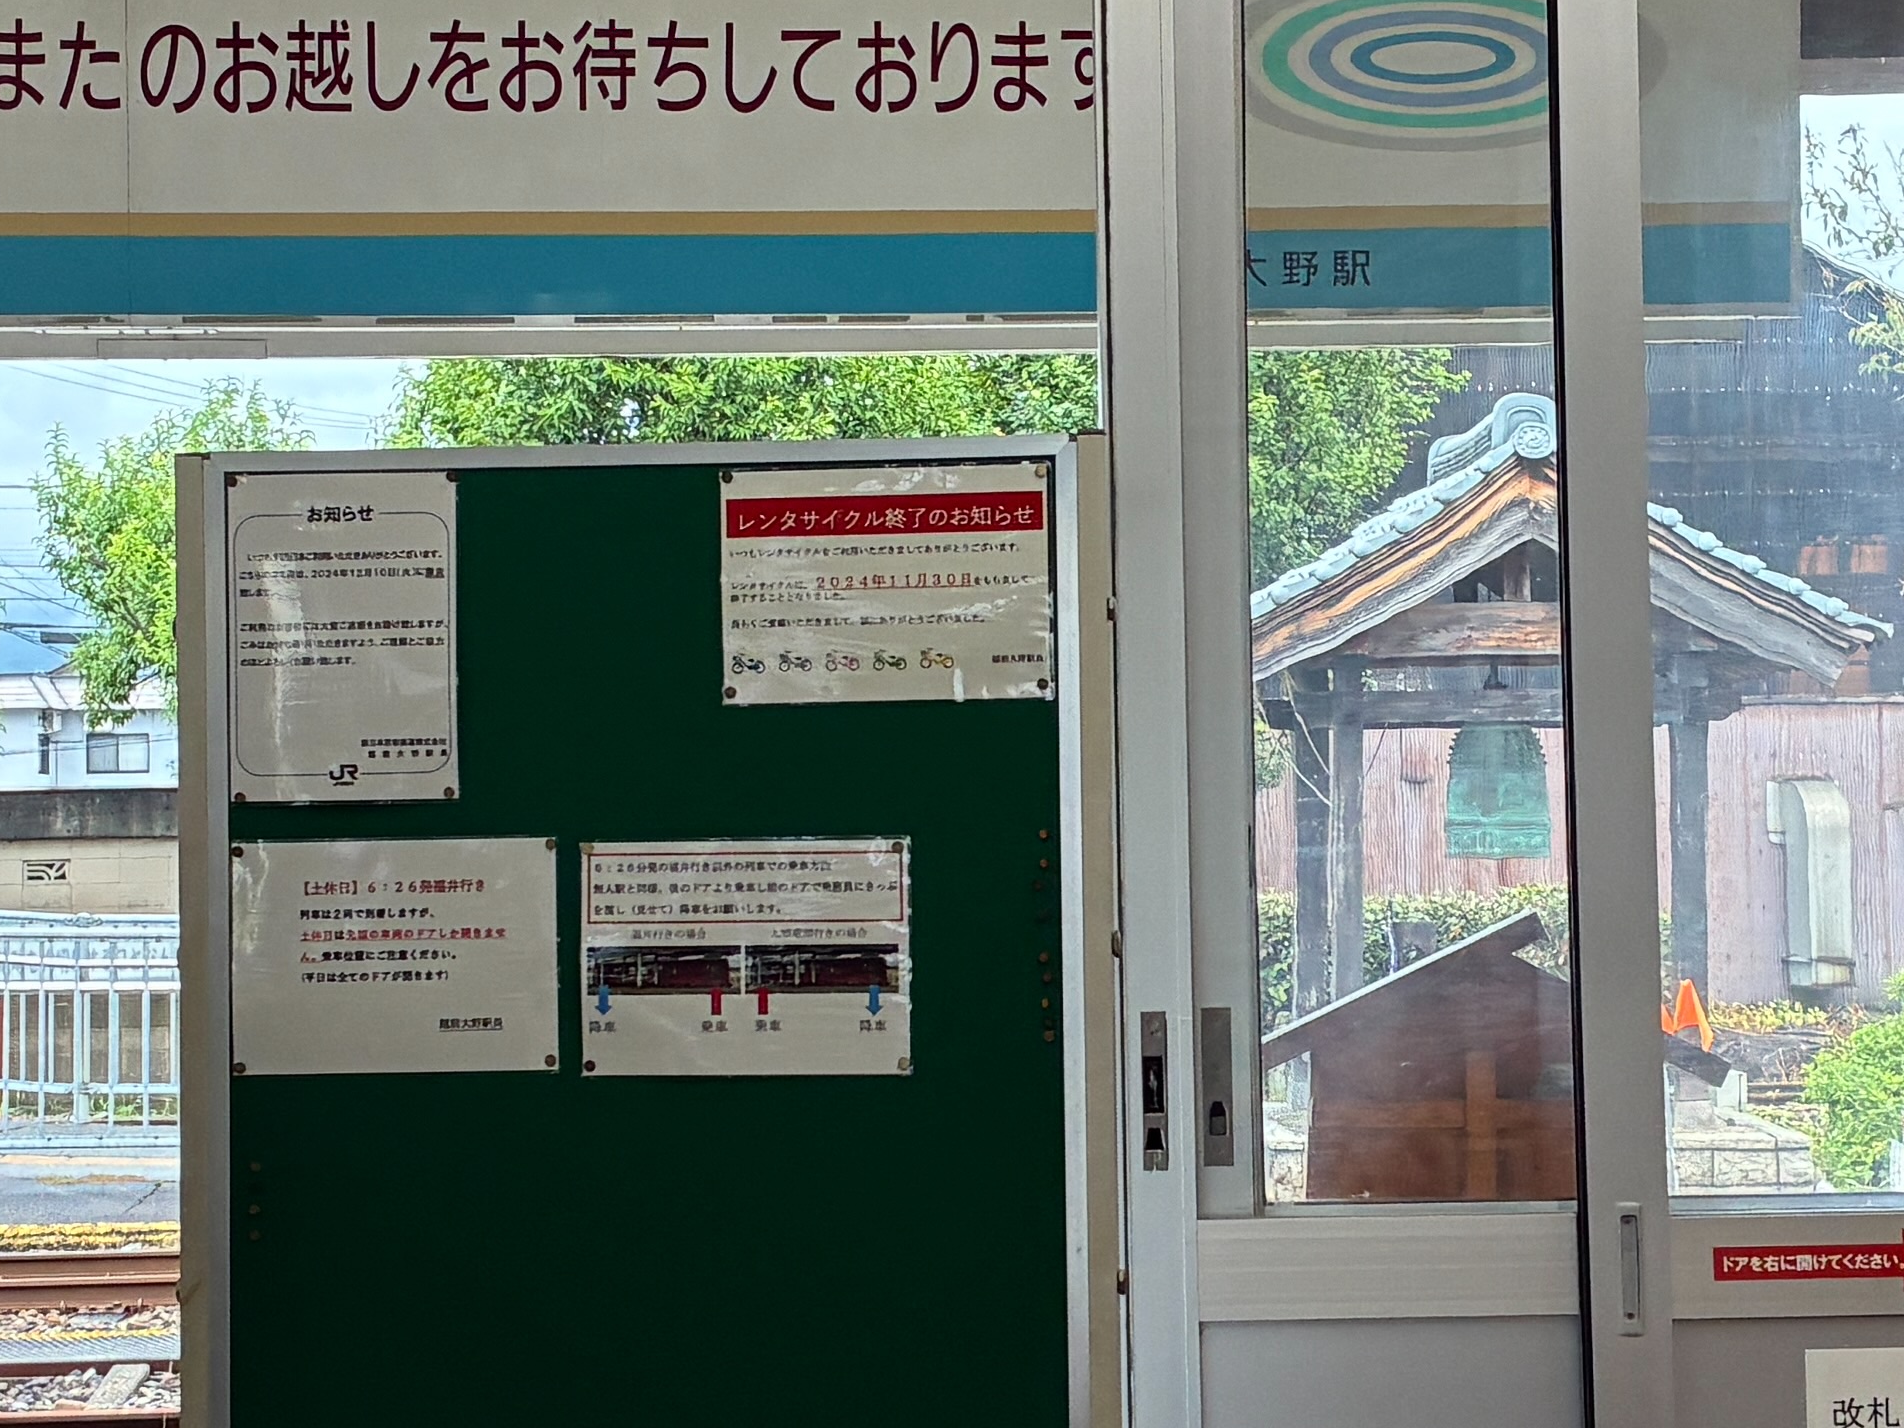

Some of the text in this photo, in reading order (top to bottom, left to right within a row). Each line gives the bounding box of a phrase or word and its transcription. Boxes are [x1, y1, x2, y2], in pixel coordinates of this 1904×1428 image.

[306, 505, 374, 522] お知らせ
[738, 506, 1035, 530] レンタサイクル終了のお知らせ
[329, 764, 359, 780] JR
